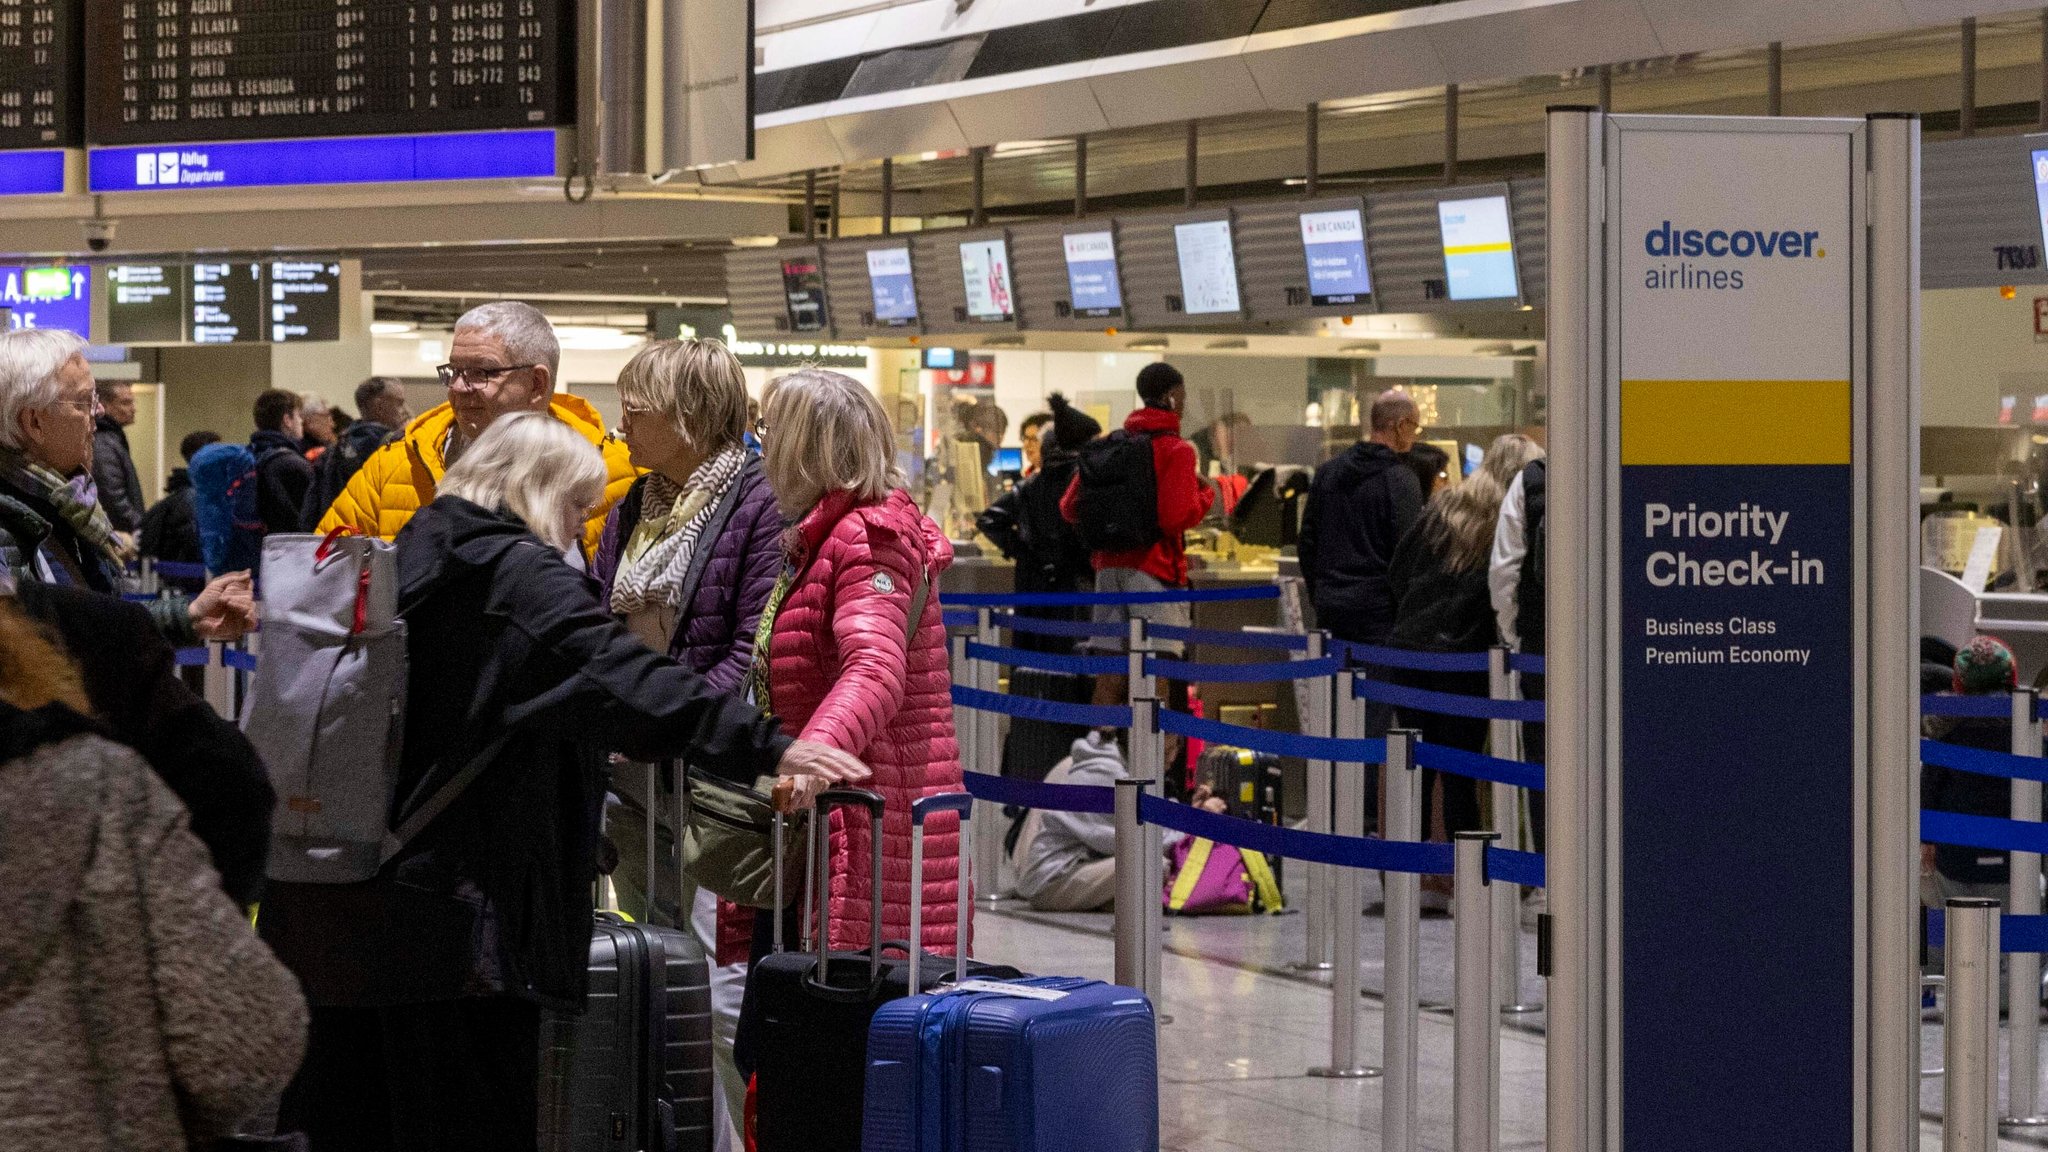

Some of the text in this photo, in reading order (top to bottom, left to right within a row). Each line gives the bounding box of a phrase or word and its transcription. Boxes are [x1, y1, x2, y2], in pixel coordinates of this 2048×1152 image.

[190, 18, 239, 35] ATLANTA
[428, 28, 437, 43] A
[428, 49, 437, 65] A
[190, 81, 233, 98] ANKARA
[190, 103, 225, 119] BASEL
[428, 92, 437, 108] A
[181, 151, 208, 168] Abflug
[181, 169, 225, 184] Departures
[1329, 220, 1356, 232] CANADA
[1645, 262, 1744, 289] airlines
[1645, 502, 1790, 545] Priority
[1646, 550, 1824, 587] Check-in
[1646, 616, 1777, 636] Business Class
[1646, 645, 1811, 666] Premium Economy
